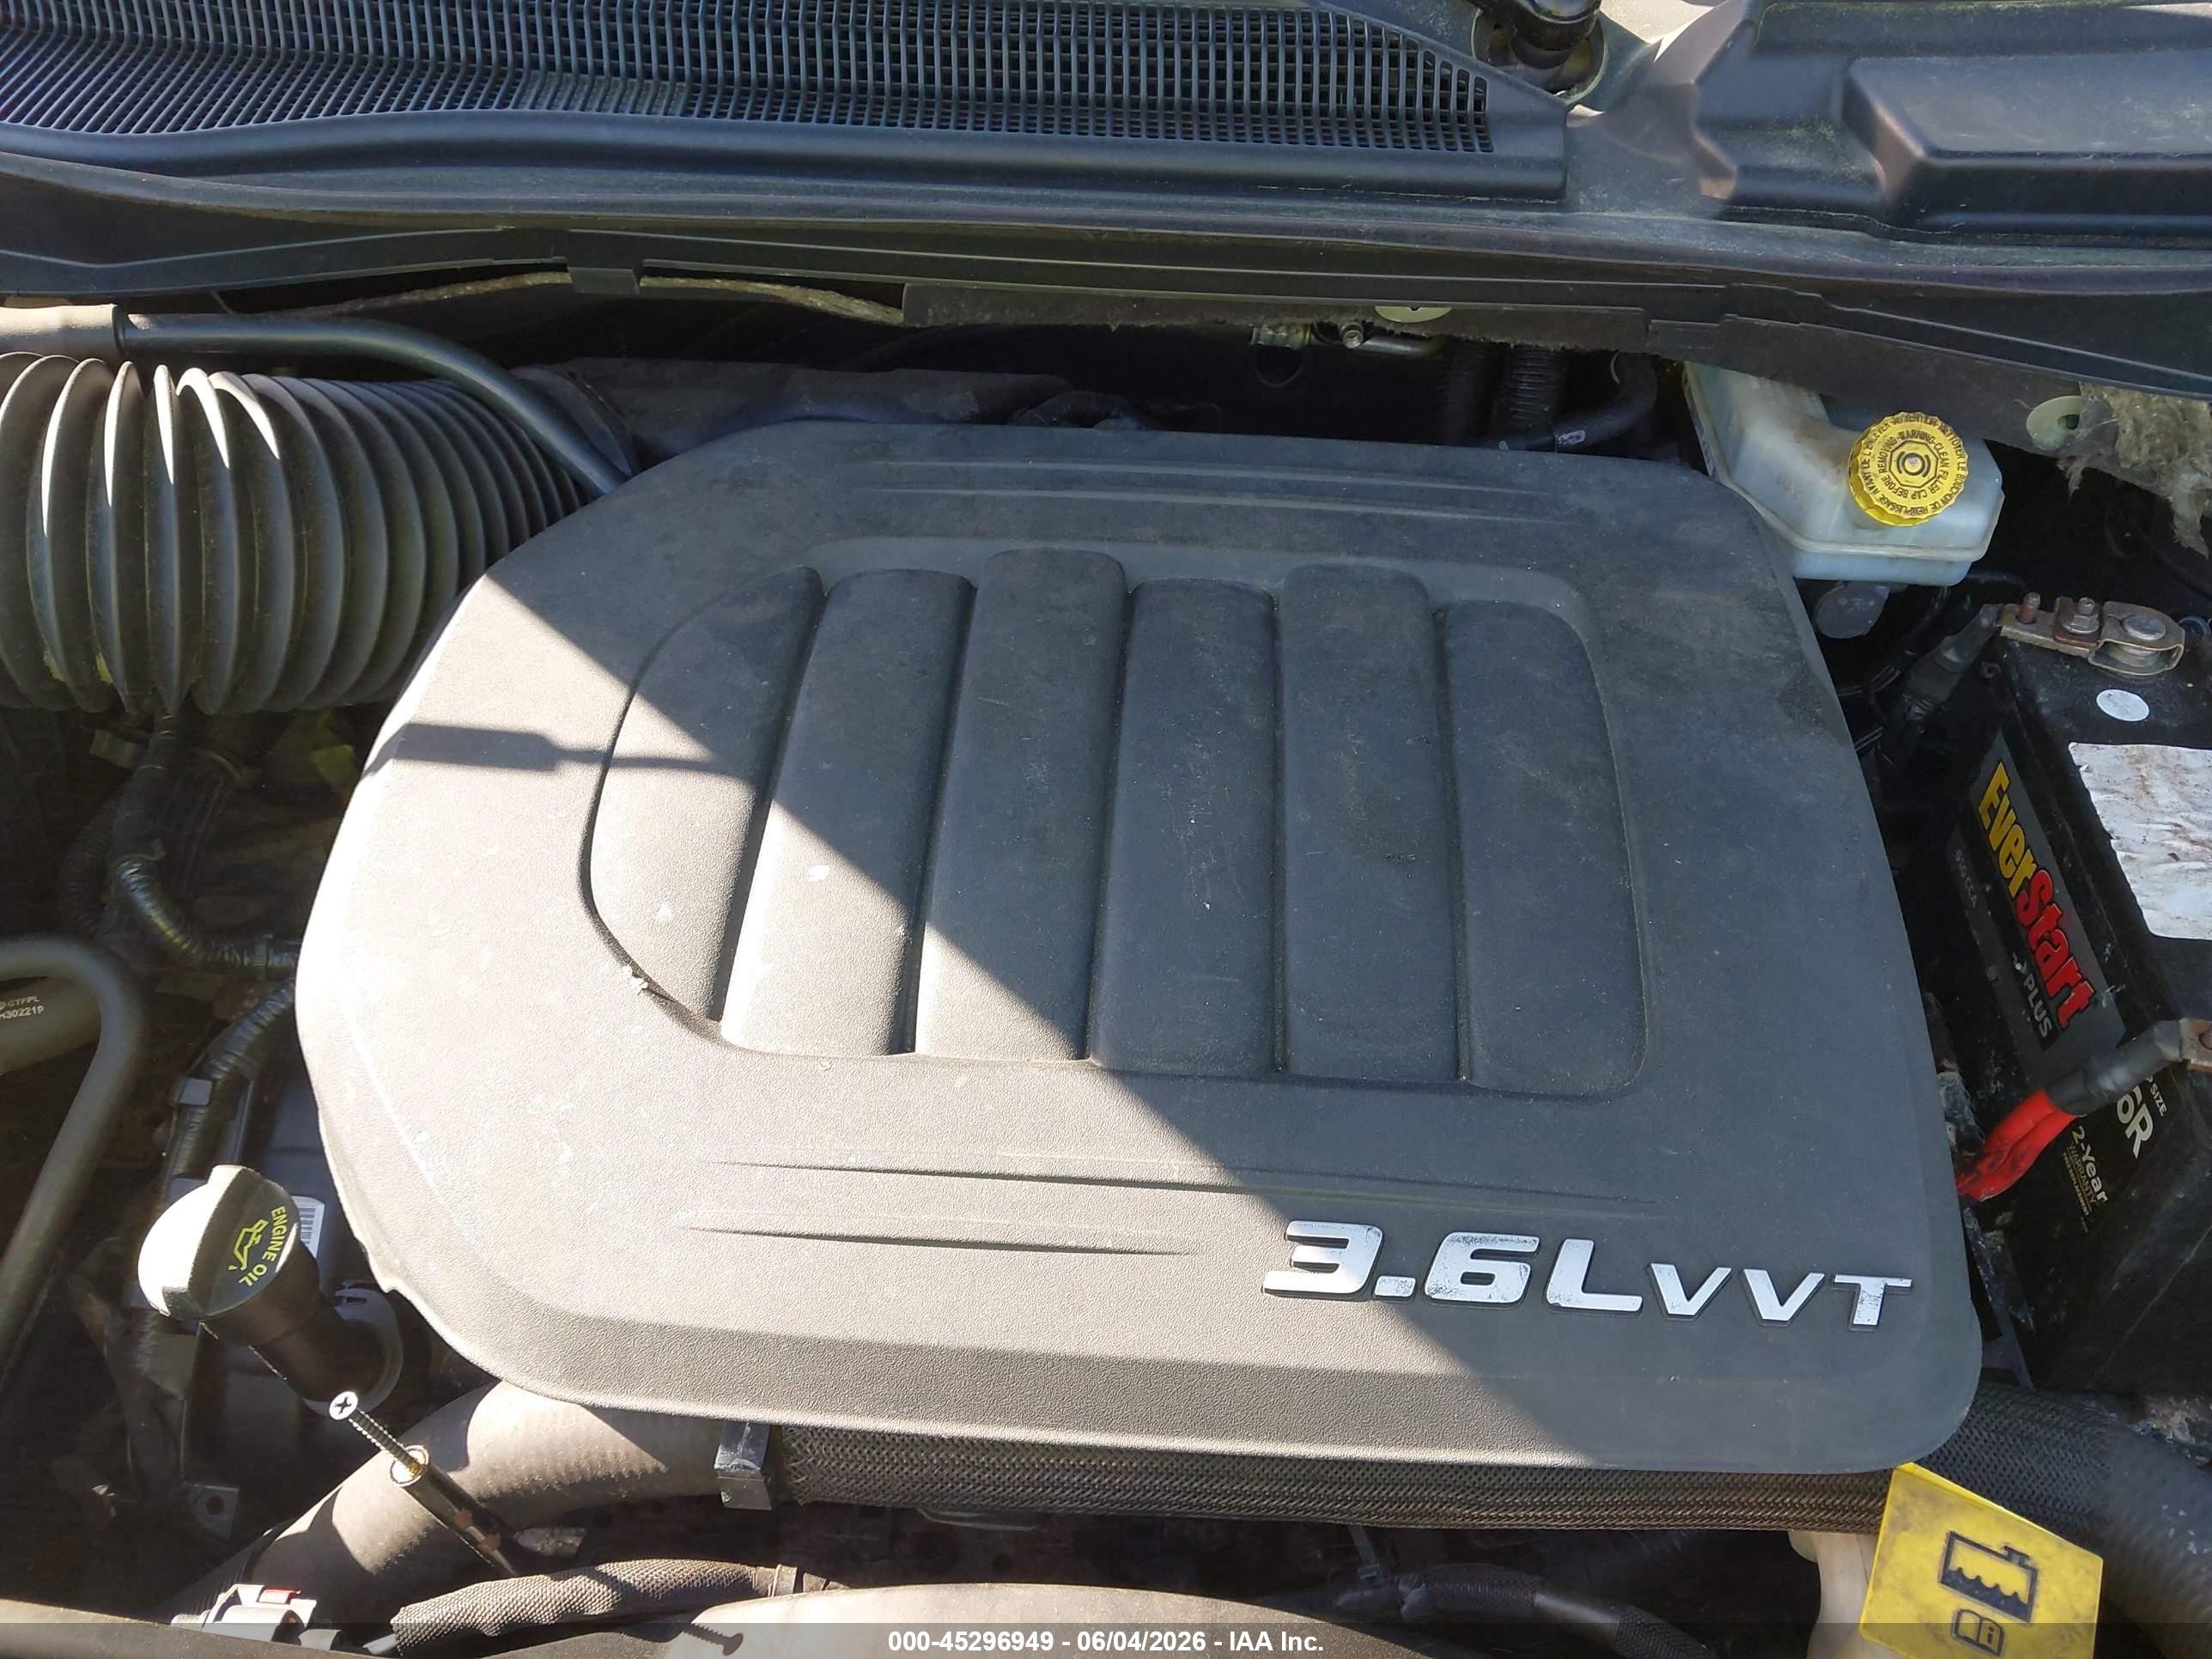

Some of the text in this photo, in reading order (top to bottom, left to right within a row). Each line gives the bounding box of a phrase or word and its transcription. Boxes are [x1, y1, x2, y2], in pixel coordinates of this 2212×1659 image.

[1881, 475, 1909, 498] BEFORE
[1911, 489, 1928, 500] CAP
[1928, 470, 1949, 494] FILLER
[2023, 975, 2053, 1037] PLUS
[2150, 1083, 2167, 1117] SIZE
[2069, 1142, 2097, 1203] WARRANTY
[2071, 1126, 2108, 1202] 2-Year
[239, 1206, 288, 1286] ENGINE OIL
